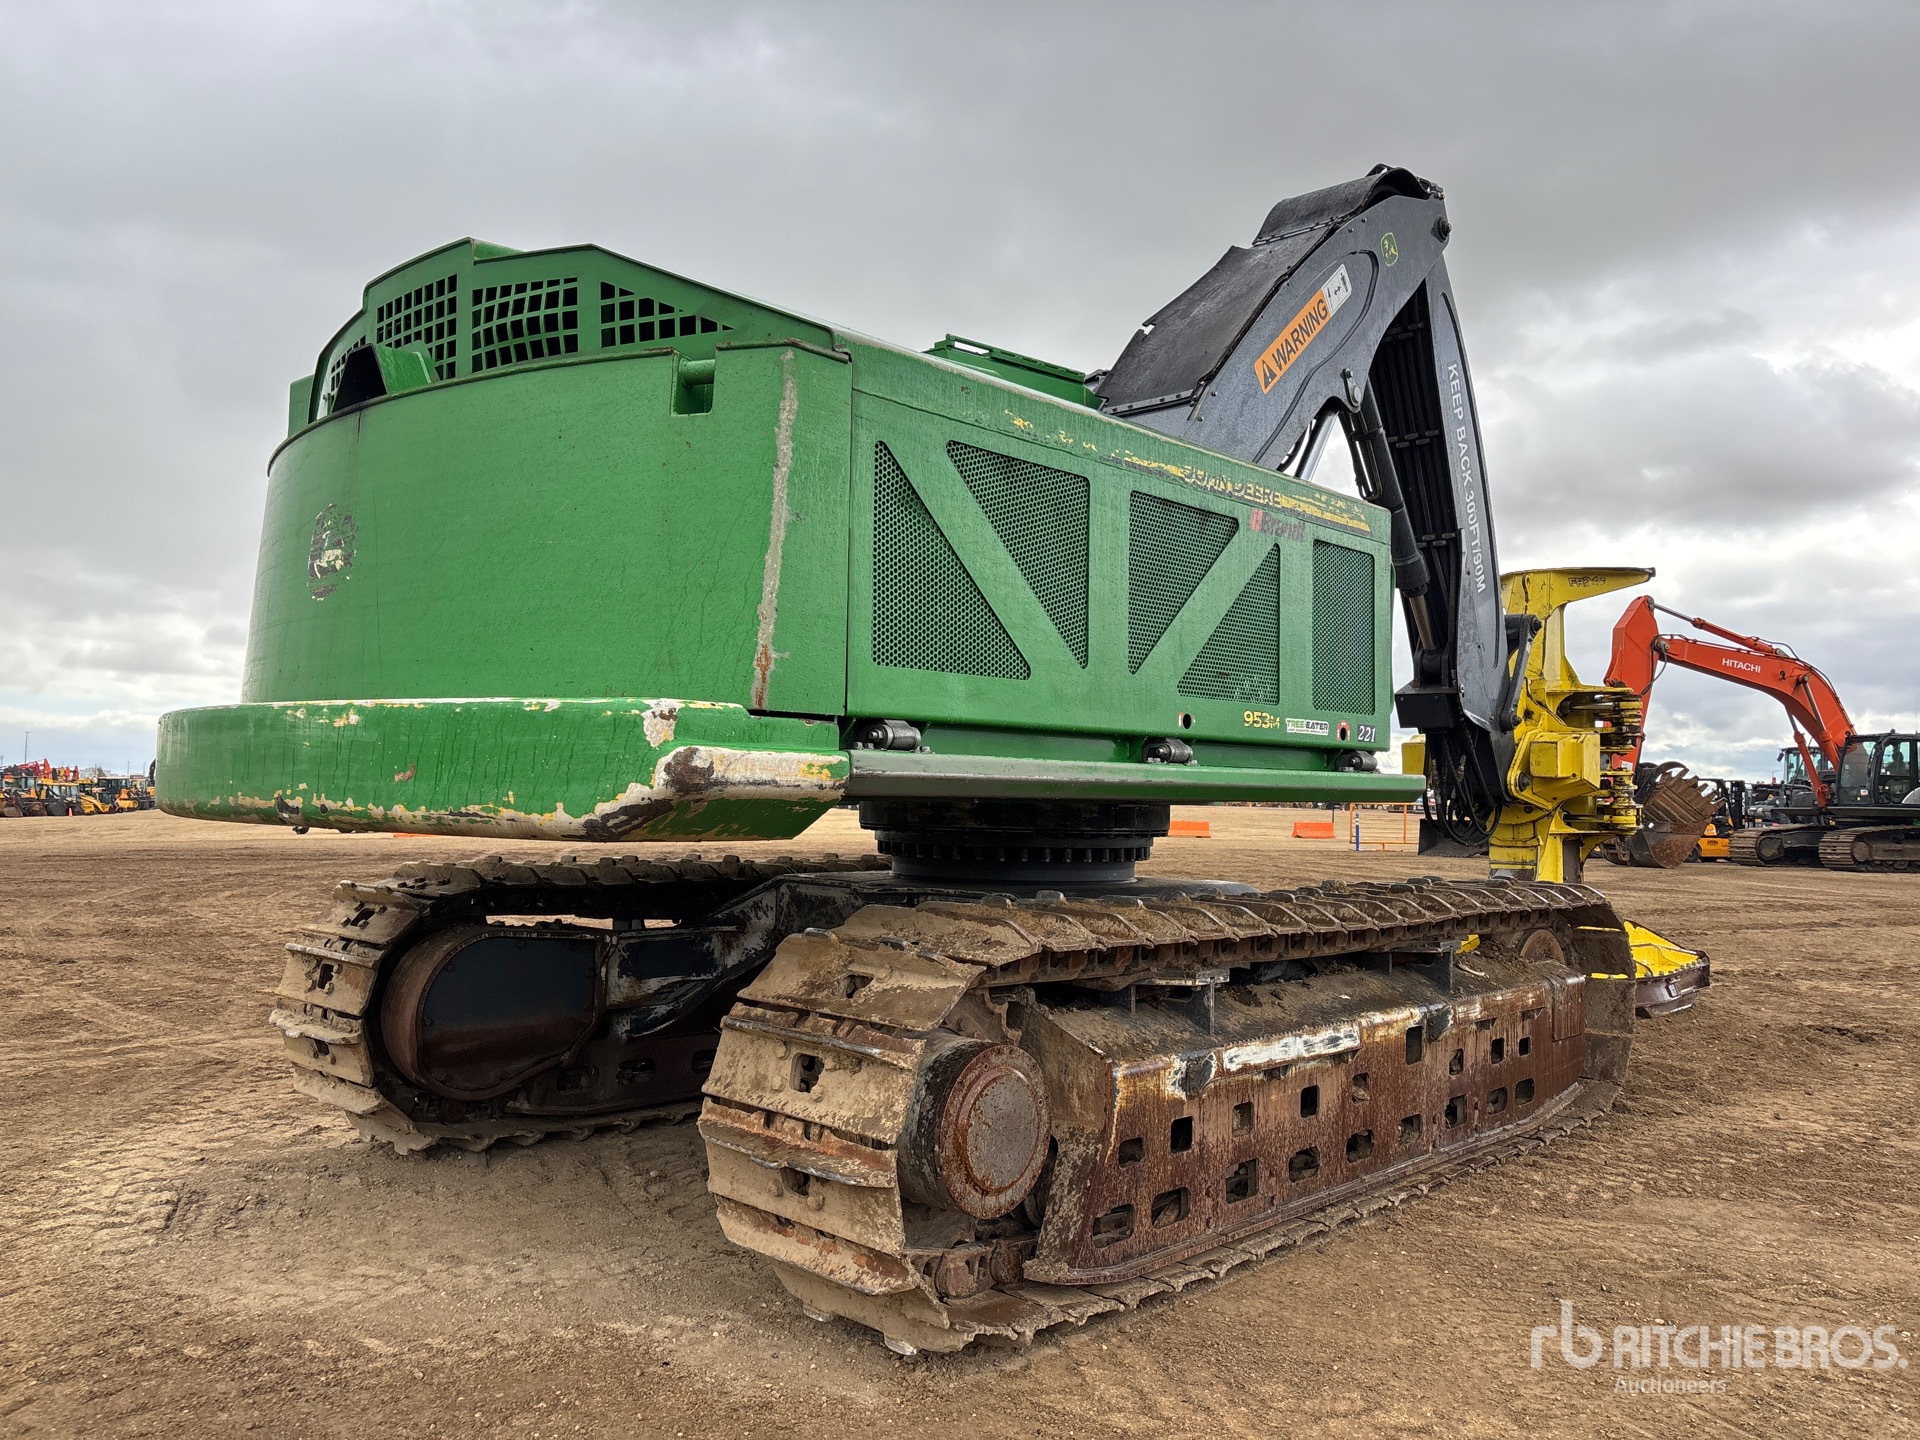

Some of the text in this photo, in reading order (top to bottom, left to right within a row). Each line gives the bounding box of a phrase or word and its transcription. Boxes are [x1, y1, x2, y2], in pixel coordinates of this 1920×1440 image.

[1271, 298, 1329, 372] WARNING
[1447, 363, 1464, 420] KEEP
[1456, 425, 1473, 488] BACK
[1721, 657, 1762, 674] HITACHI
[1286, 719, 1329, 731] TREE EATER
[1357, 725, 1376, 743] 221
